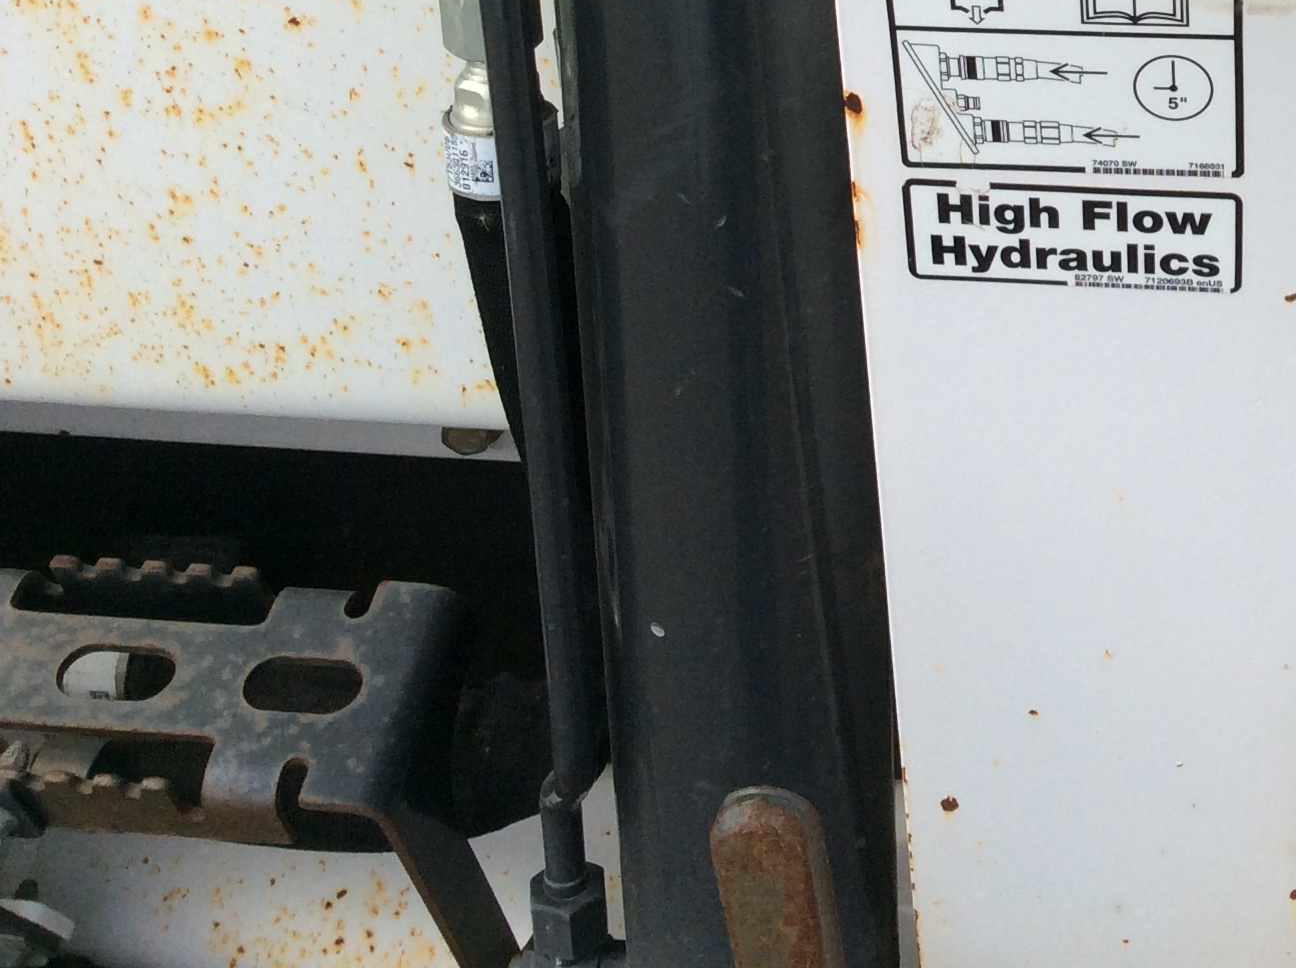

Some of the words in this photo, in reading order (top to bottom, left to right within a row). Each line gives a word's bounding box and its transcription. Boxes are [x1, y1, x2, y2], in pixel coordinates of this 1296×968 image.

[1092, 159, 1119, 167] 74070
[1122, 160, 1137, 168] SW
[936, 193, 1060, 233] High
[1082, 199, 1213, 236] Flow
[931, 235, 1221, 277] Hydraulics
[1107, 275, 1124, 283] SW
